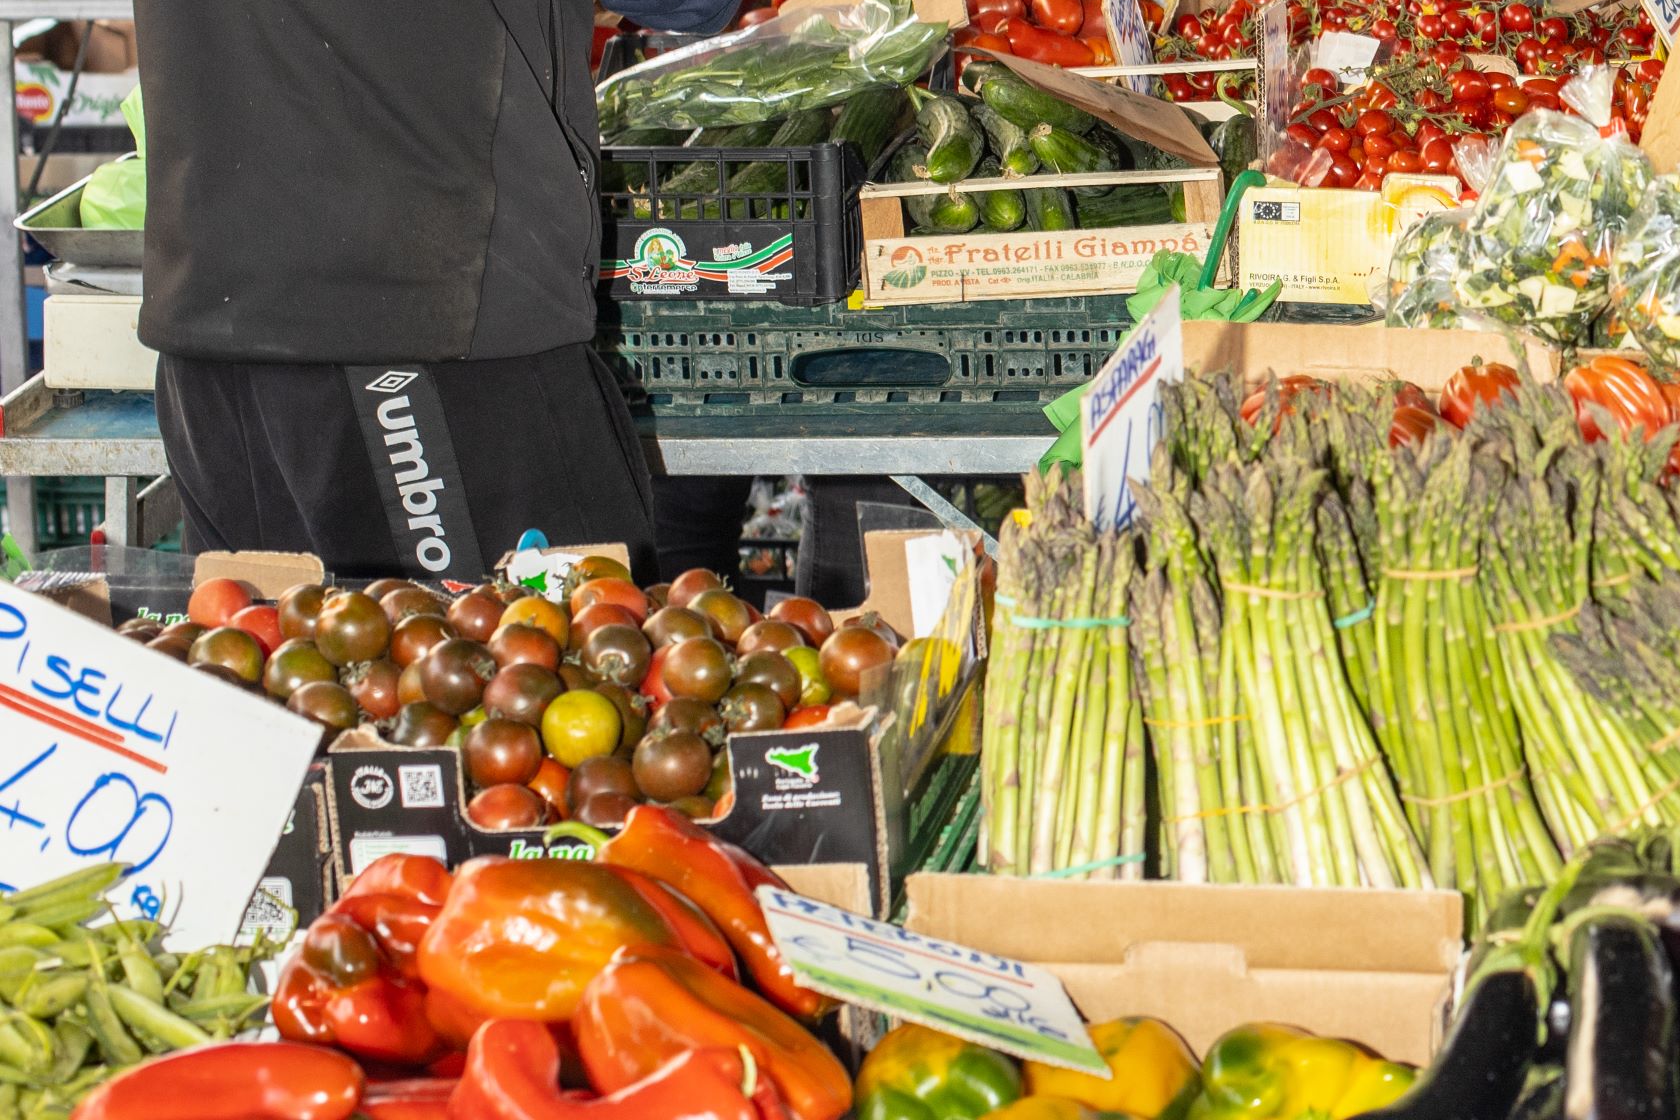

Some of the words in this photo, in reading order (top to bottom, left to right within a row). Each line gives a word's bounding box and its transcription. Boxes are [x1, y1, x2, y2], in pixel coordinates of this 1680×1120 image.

[944, 239, 1063, 266] Fratelli
[1300, 274, 1317, 285] Figli
[376, 395, 451, 572] umbro
